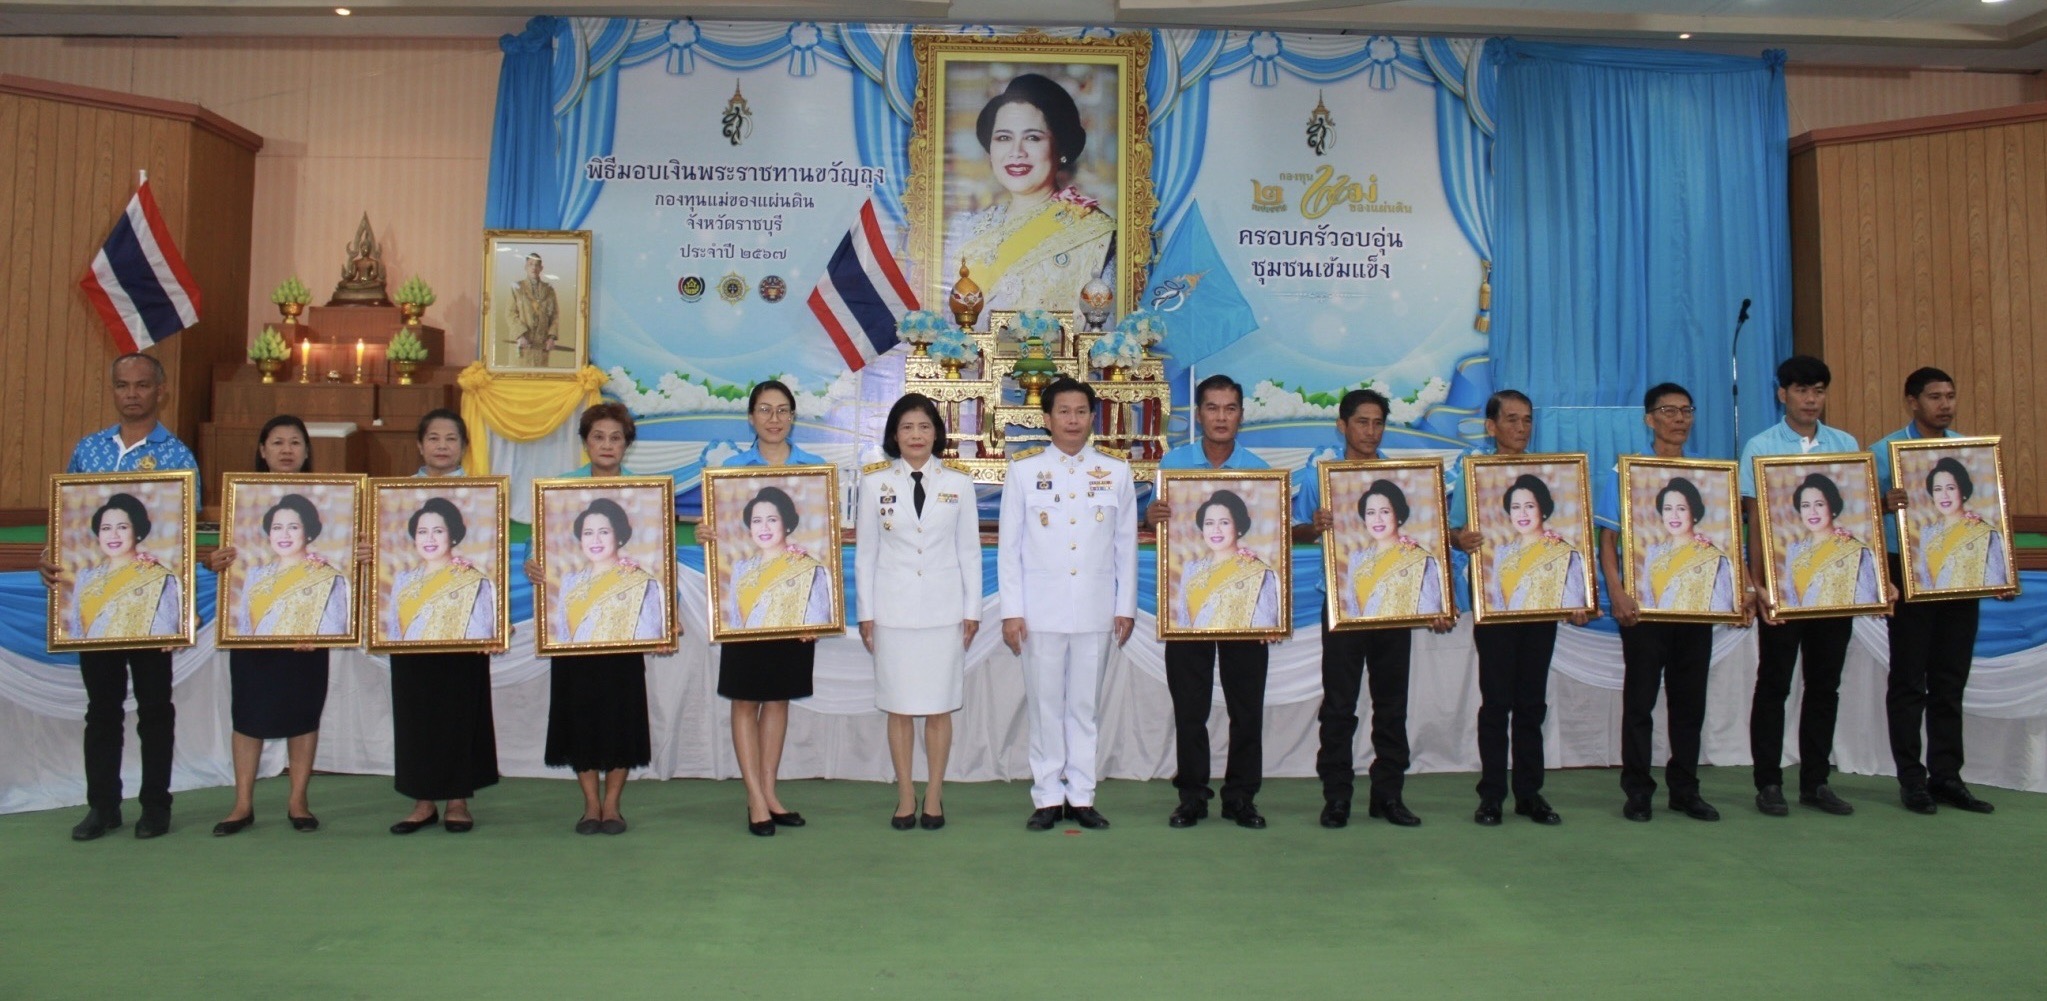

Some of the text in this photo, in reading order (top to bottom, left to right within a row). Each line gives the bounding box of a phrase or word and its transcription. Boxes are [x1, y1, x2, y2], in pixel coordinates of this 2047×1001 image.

[586, 156, 885, 191] พิธีมอบเงินพระราชทานขวัญถุง
[654, 191, 815, 212] กองทุนแม่ของแผ่นดิน
[686, 213, 783, 237] จังหวัดราชบุรี
[679, 242, 788, 260] ประจำปี ๒๕๖๗
[1238, 223, 1404, 256] ครอบครัวอบอุ่น
[1251, 254, 1391, 285] ชุมชนเข้มแข็ง
